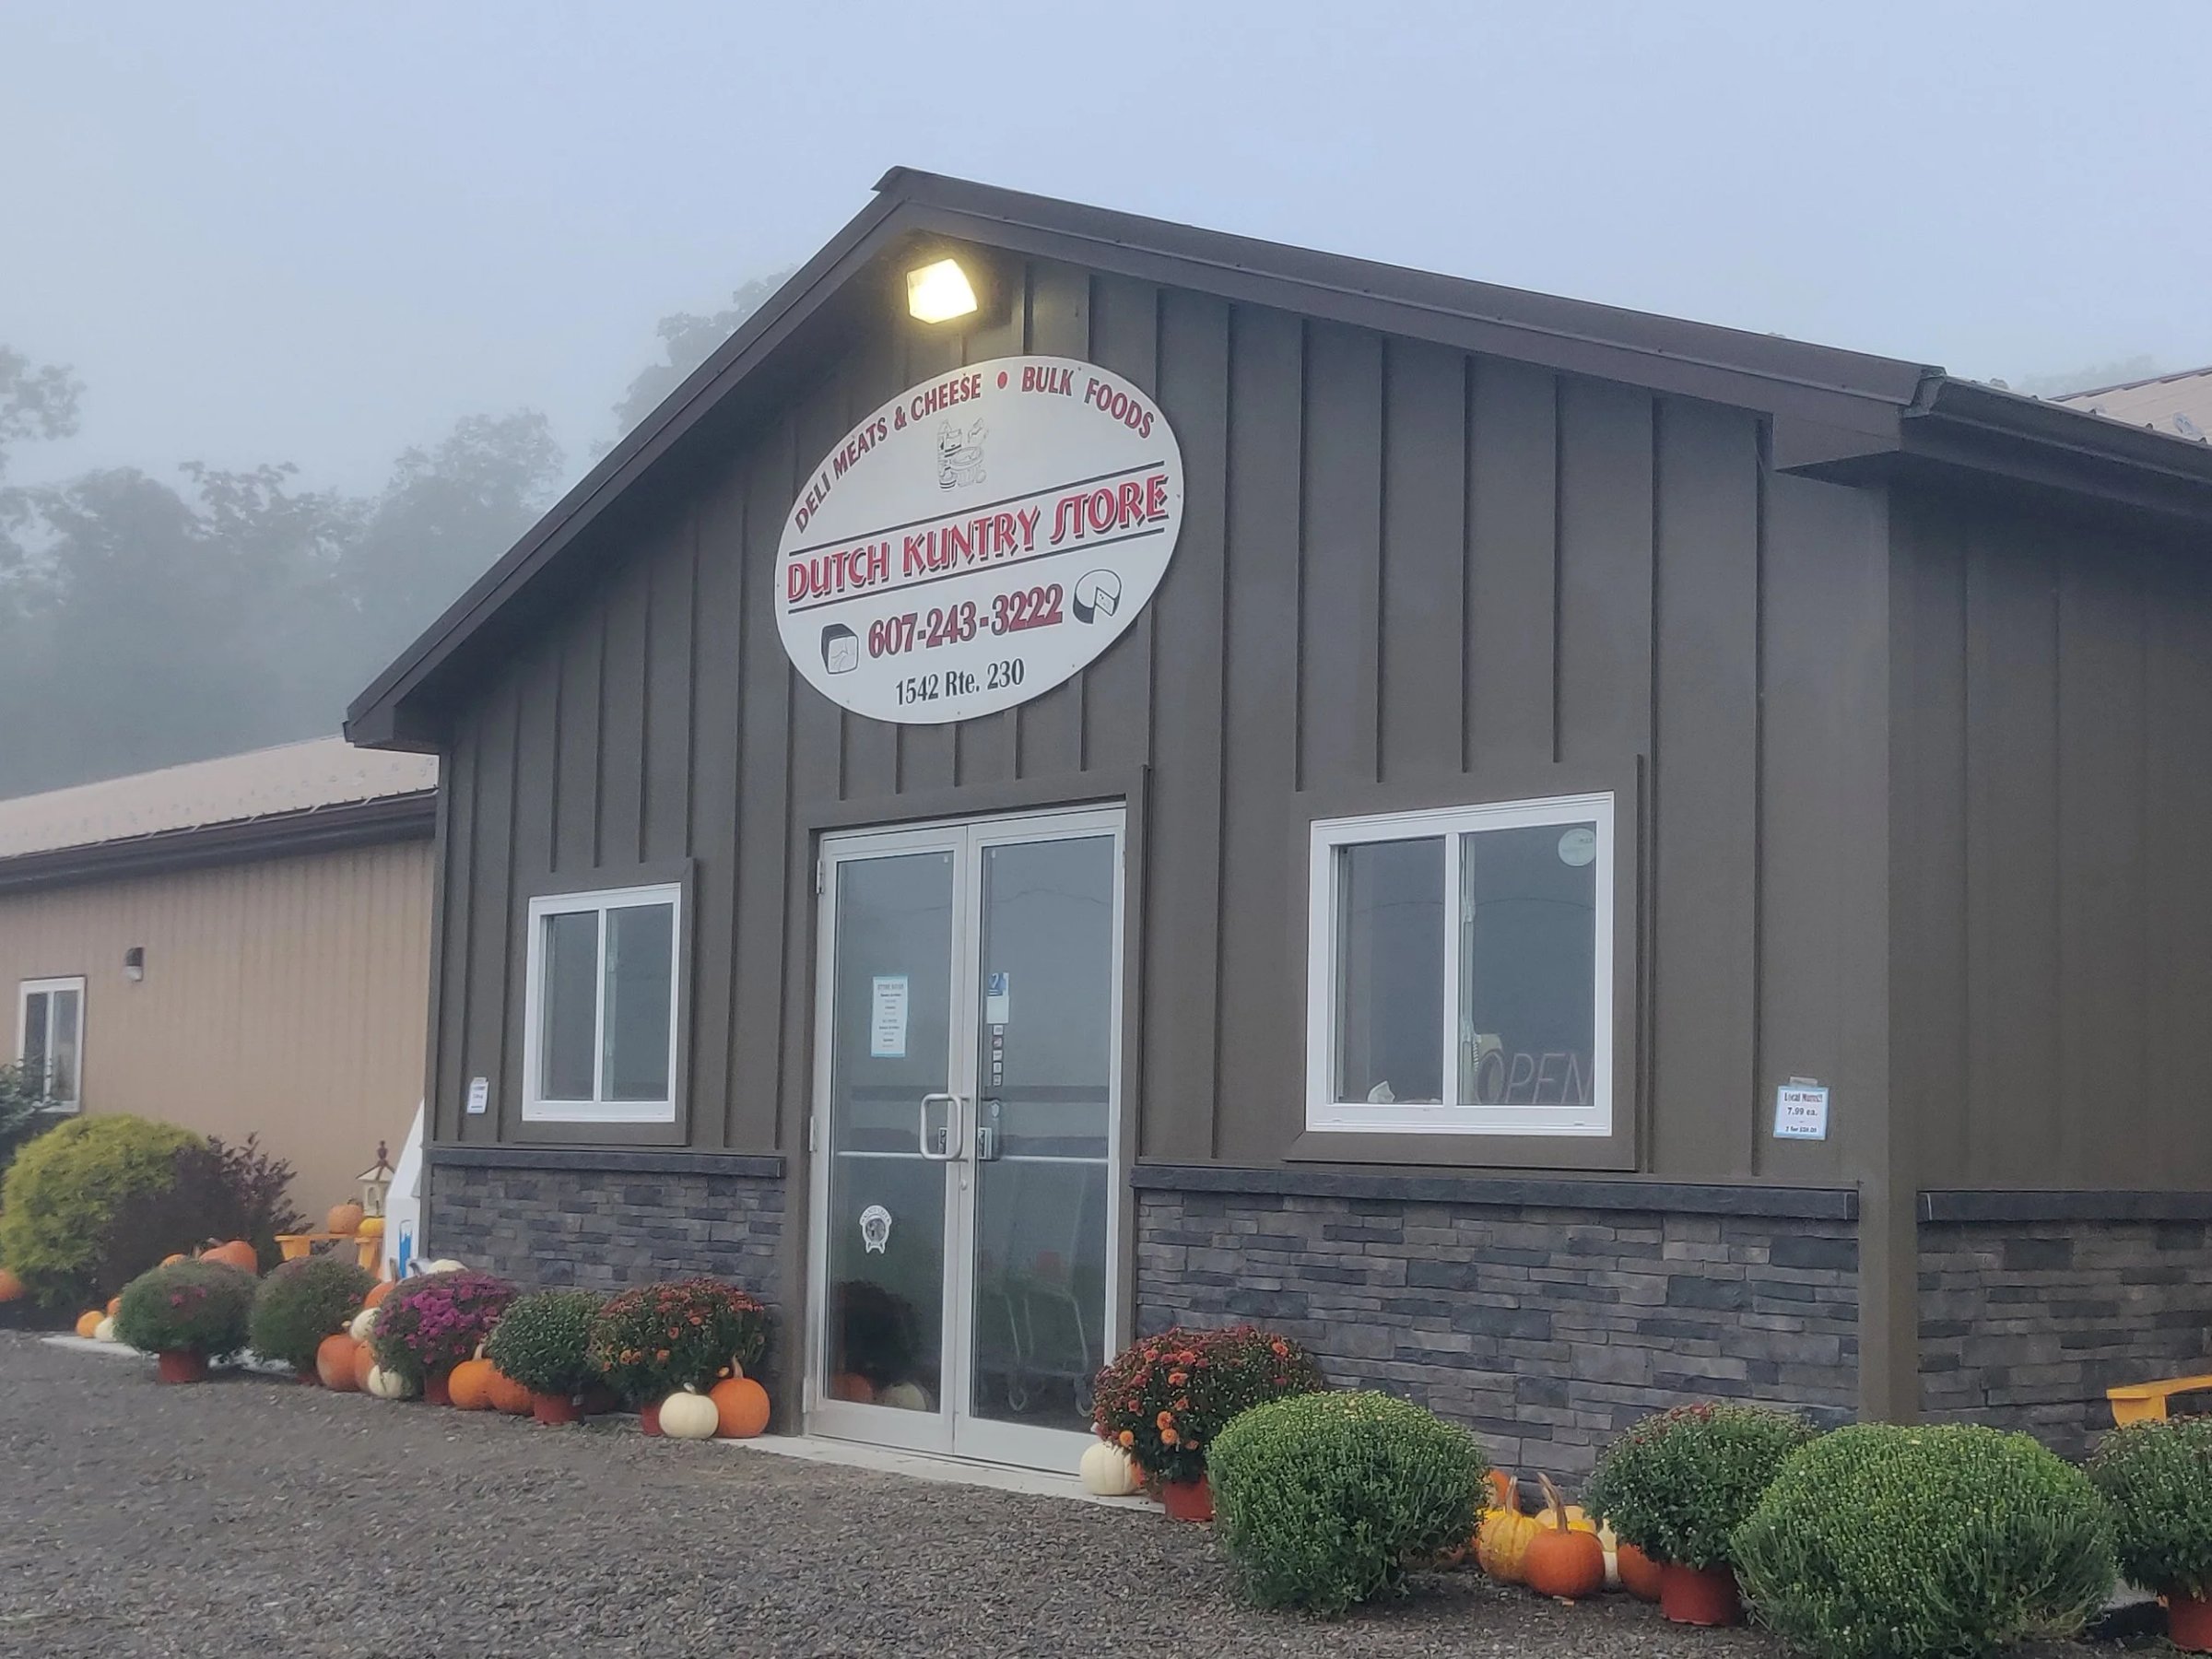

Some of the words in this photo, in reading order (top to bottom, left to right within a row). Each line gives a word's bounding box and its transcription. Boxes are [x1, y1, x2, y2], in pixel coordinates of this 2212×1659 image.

[794, 471, 831, 534] DELI
[832, 418, 888, 480] MEATS
[894, 406, 908, 430] &
[911, 373, 982, 421] CHEESE
[1021, 366, 1075, 396] BULK
[1084, 378, 1155, 439] FOODS
[787, 541, 890, 604] DUTCH
[902, 505, 1041, 576] KUNTRY
[1049, 474, 1170, 545] STORE
[868, 583, 1064, 658] 607-243-3222
[896, 673, 939, 706] 1542
[945, 670, 980, 698] Rte.
[987, 658, 1025, 690] 230
[1477, 1051, 1594, 1105] OPEN
[1787, 1107, 1805, 1116] 7.99
